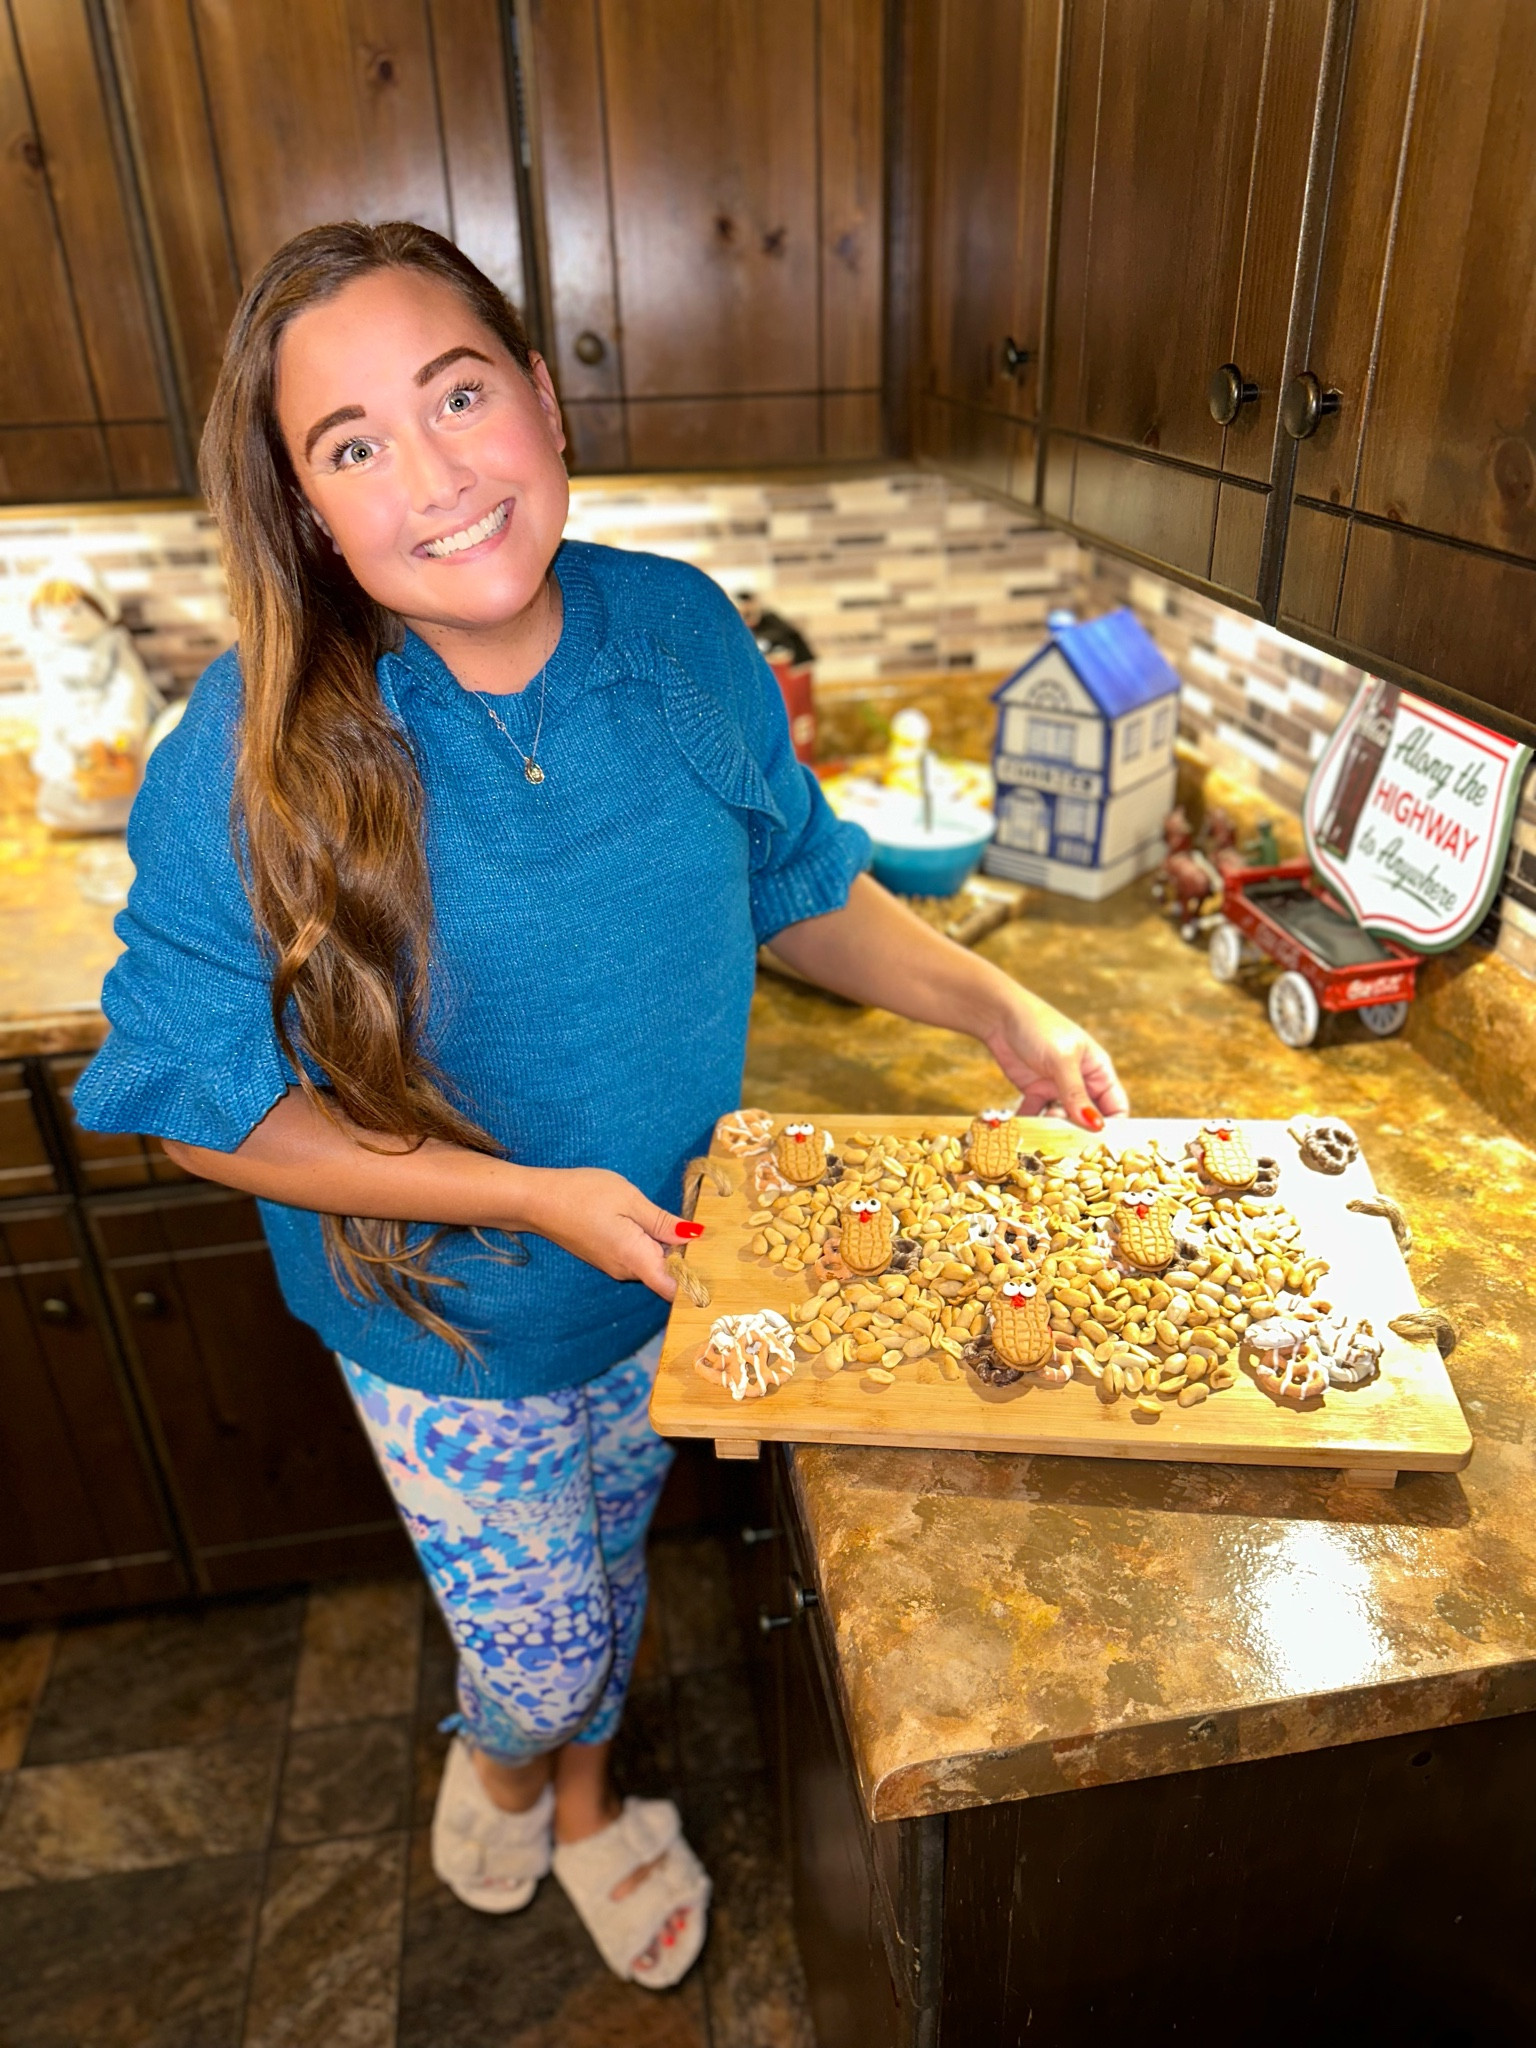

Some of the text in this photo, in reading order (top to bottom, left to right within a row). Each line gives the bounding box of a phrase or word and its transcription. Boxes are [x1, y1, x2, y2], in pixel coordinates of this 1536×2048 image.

[1393, 726, 1487, 807] Along the
[1374, 780, 1478, 863] HIGHWAY
[1358, 826, 1458, 912] to Anywhere
